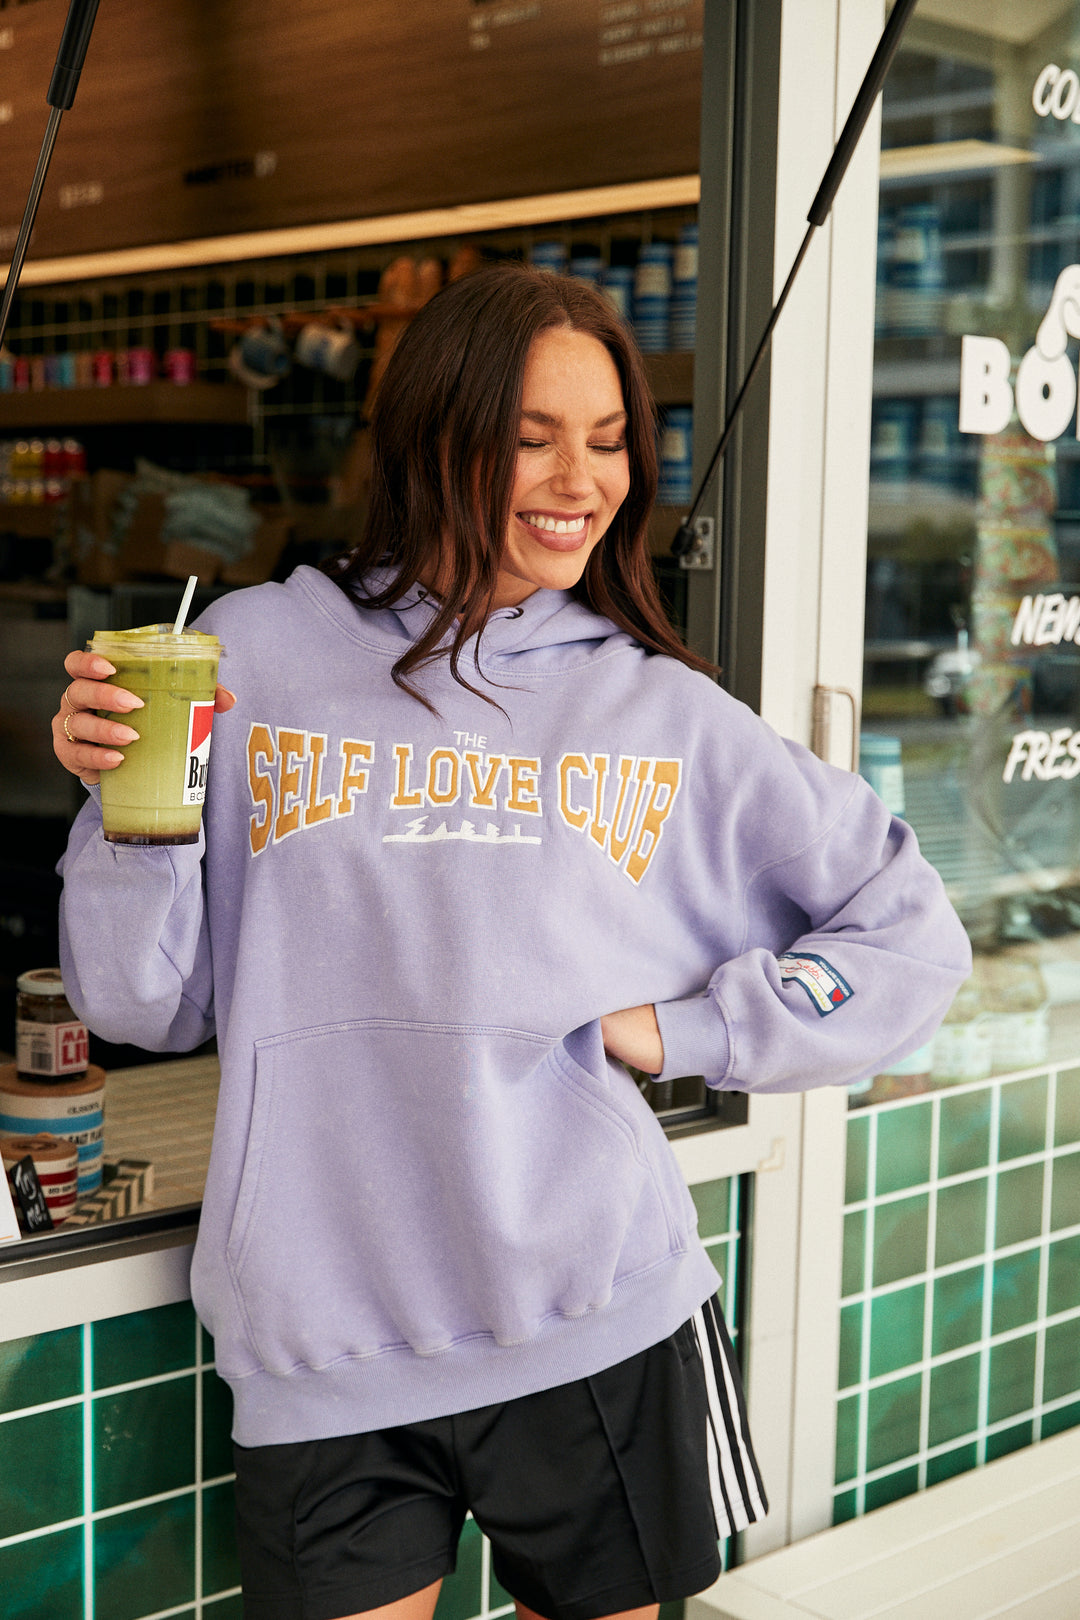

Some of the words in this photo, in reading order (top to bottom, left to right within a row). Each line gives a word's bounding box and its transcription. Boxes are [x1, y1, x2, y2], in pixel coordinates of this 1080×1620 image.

[959, 335, 1080, 441] BO
[453, 730, 488, 749] THE
[247, 722, 375, 858] SELF
[389, 743, 543, 817] LOVE
[557, 752, 683, 887] CLUB
